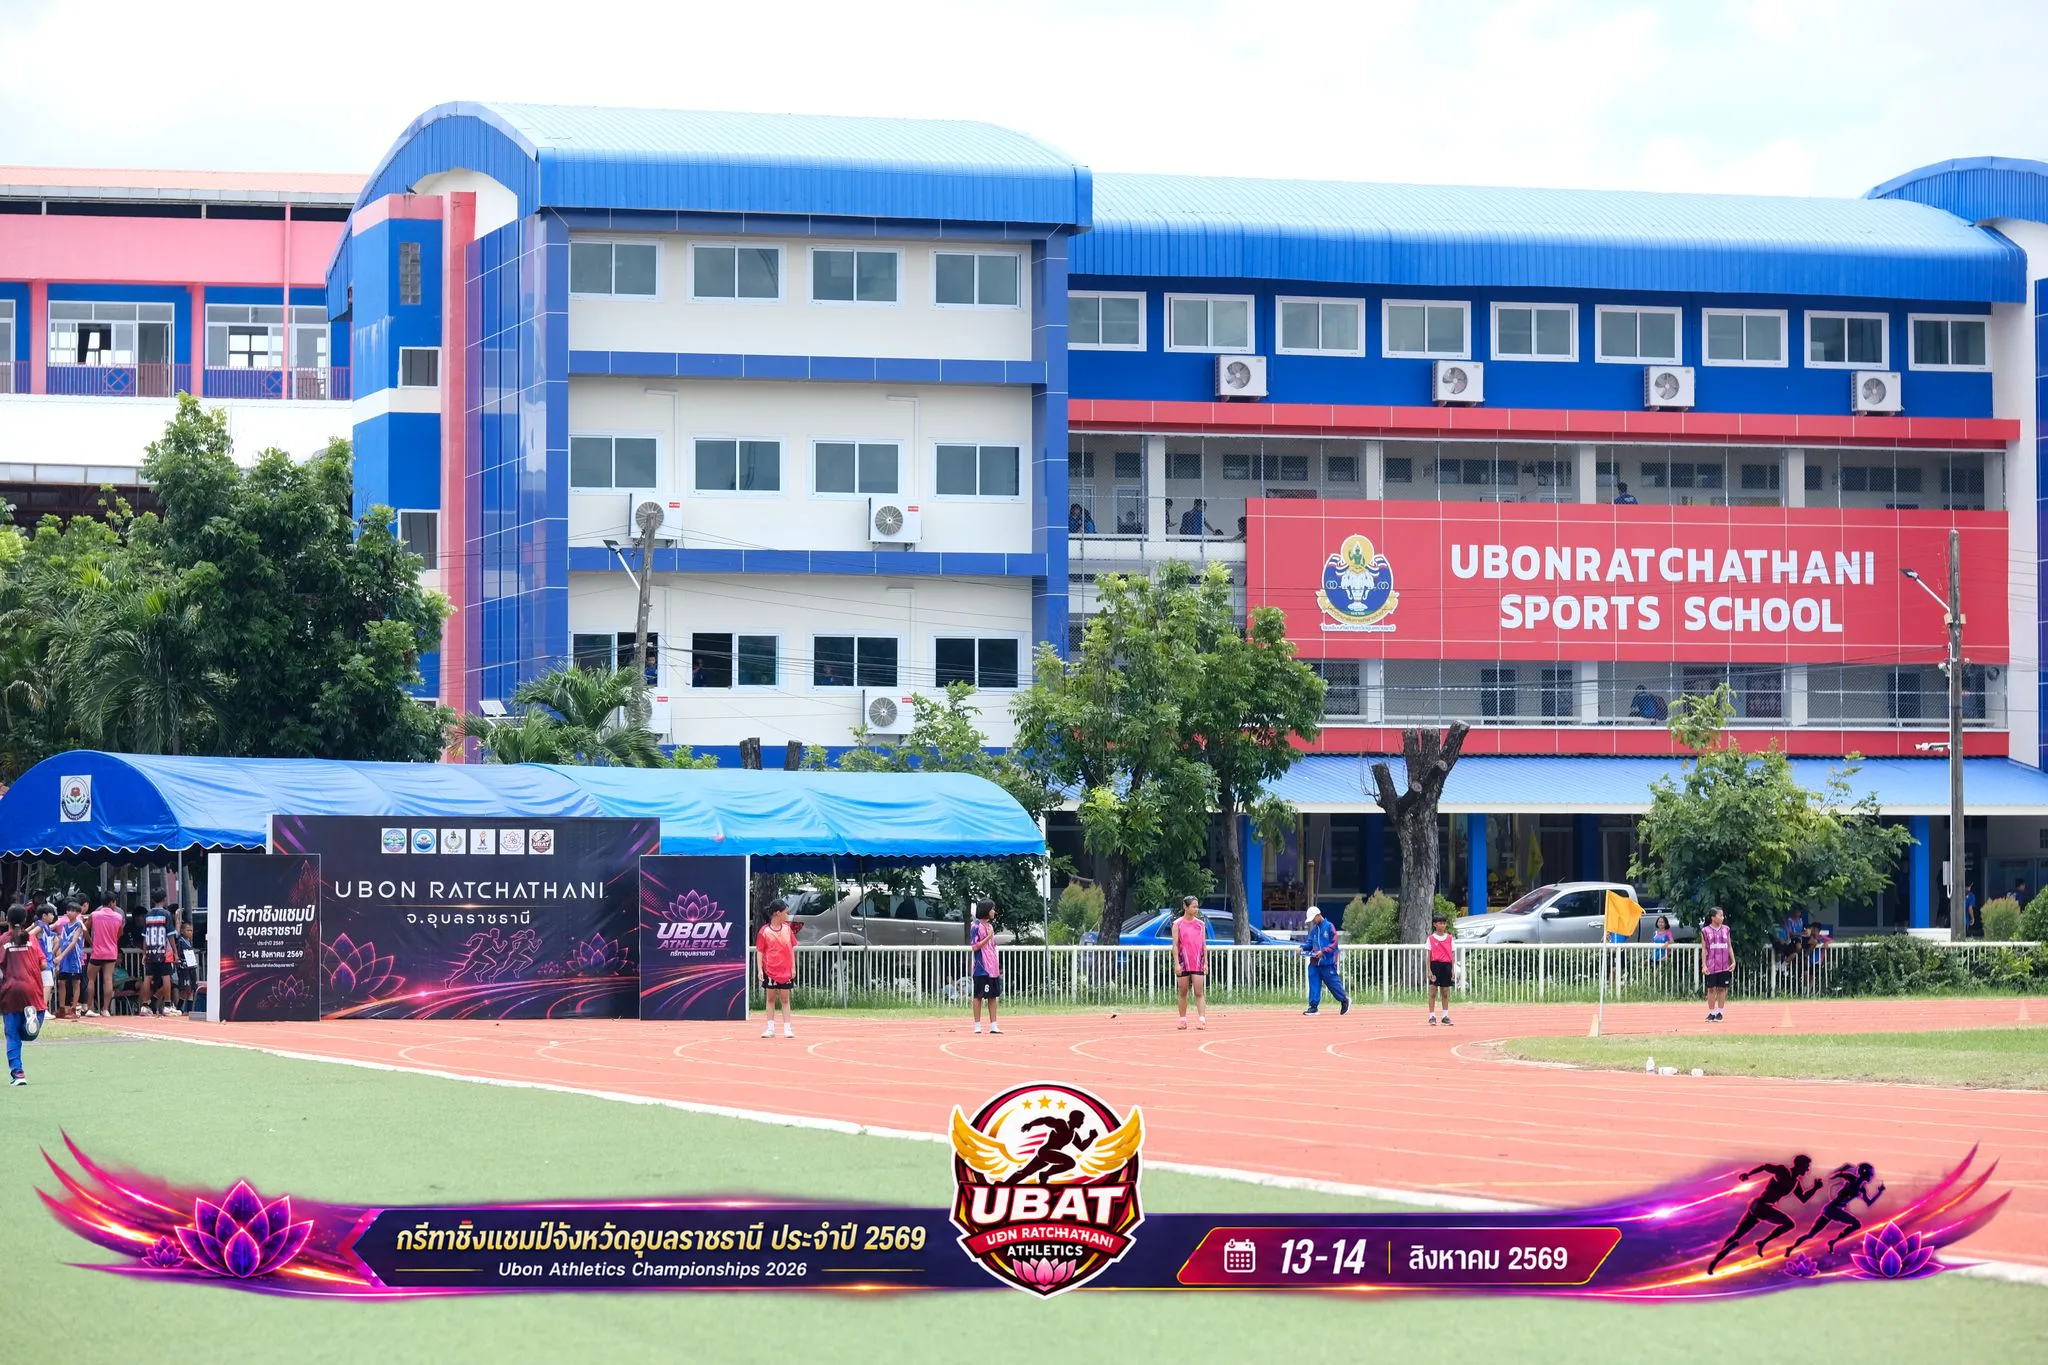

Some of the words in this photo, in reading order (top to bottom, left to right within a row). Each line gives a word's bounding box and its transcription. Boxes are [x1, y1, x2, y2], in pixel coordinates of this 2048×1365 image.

[1451, 543, 1875, 585] UBONRATCHATHANI
[1500, 593, 1661, 631] SPORTS
[1684, 596, 1844, 633] SCHOOL
[335, 880, 416, 899] UBON
[430, 881, 604, 899] RATCHATHANI
[656, 921, 733, 939] UBON
[658, 939, 729, 949] ATHLETICS
[286, 950, 304, 958] 2569
